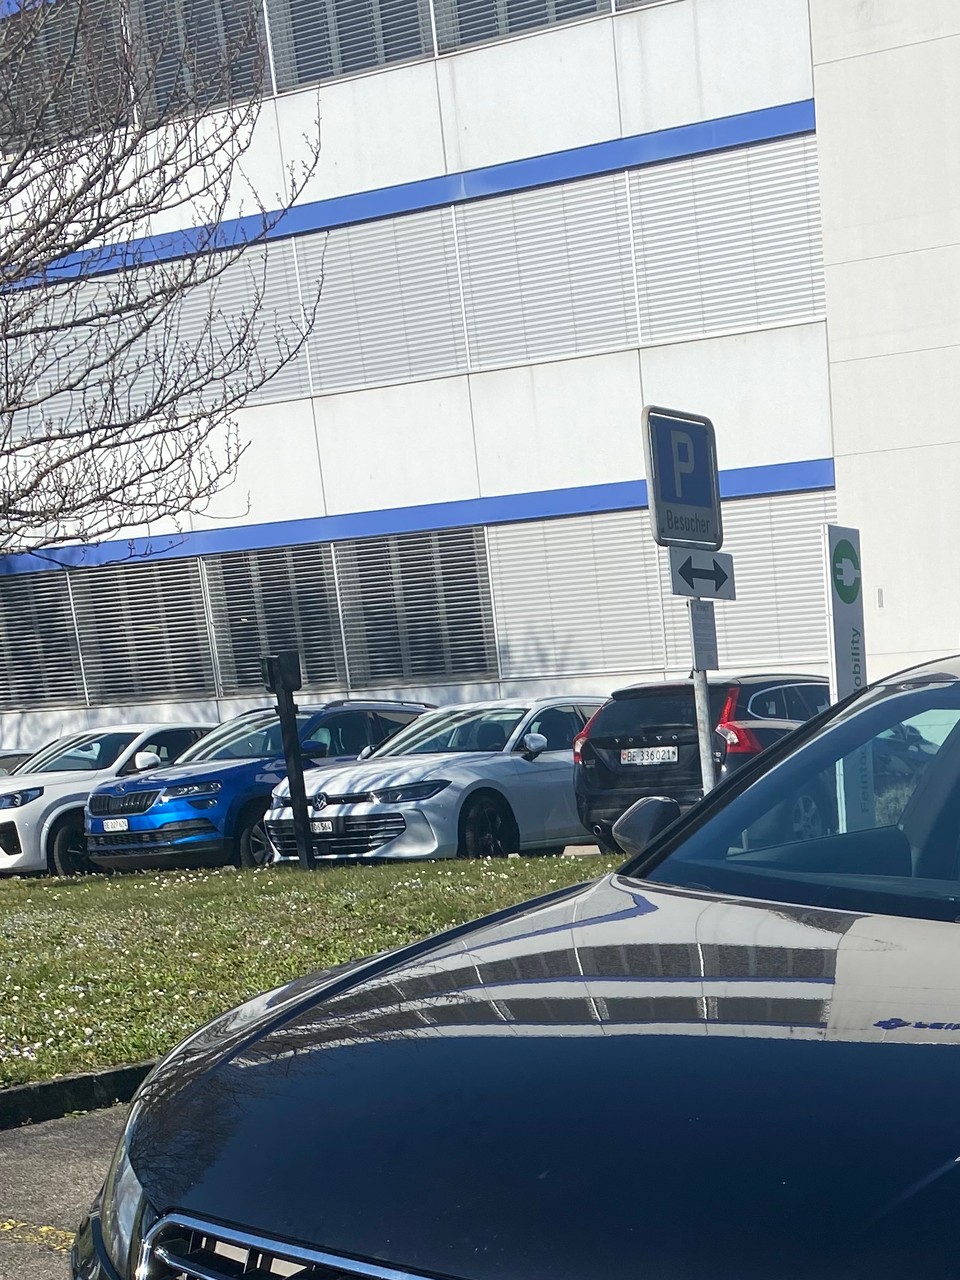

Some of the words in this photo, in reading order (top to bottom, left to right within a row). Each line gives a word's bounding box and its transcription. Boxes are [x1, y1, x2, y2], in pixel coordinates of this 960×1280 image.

[670, 430, 695, 498] P
[666, 508, 710, 535] Besucher
[851, 627, 862, 692] obility
